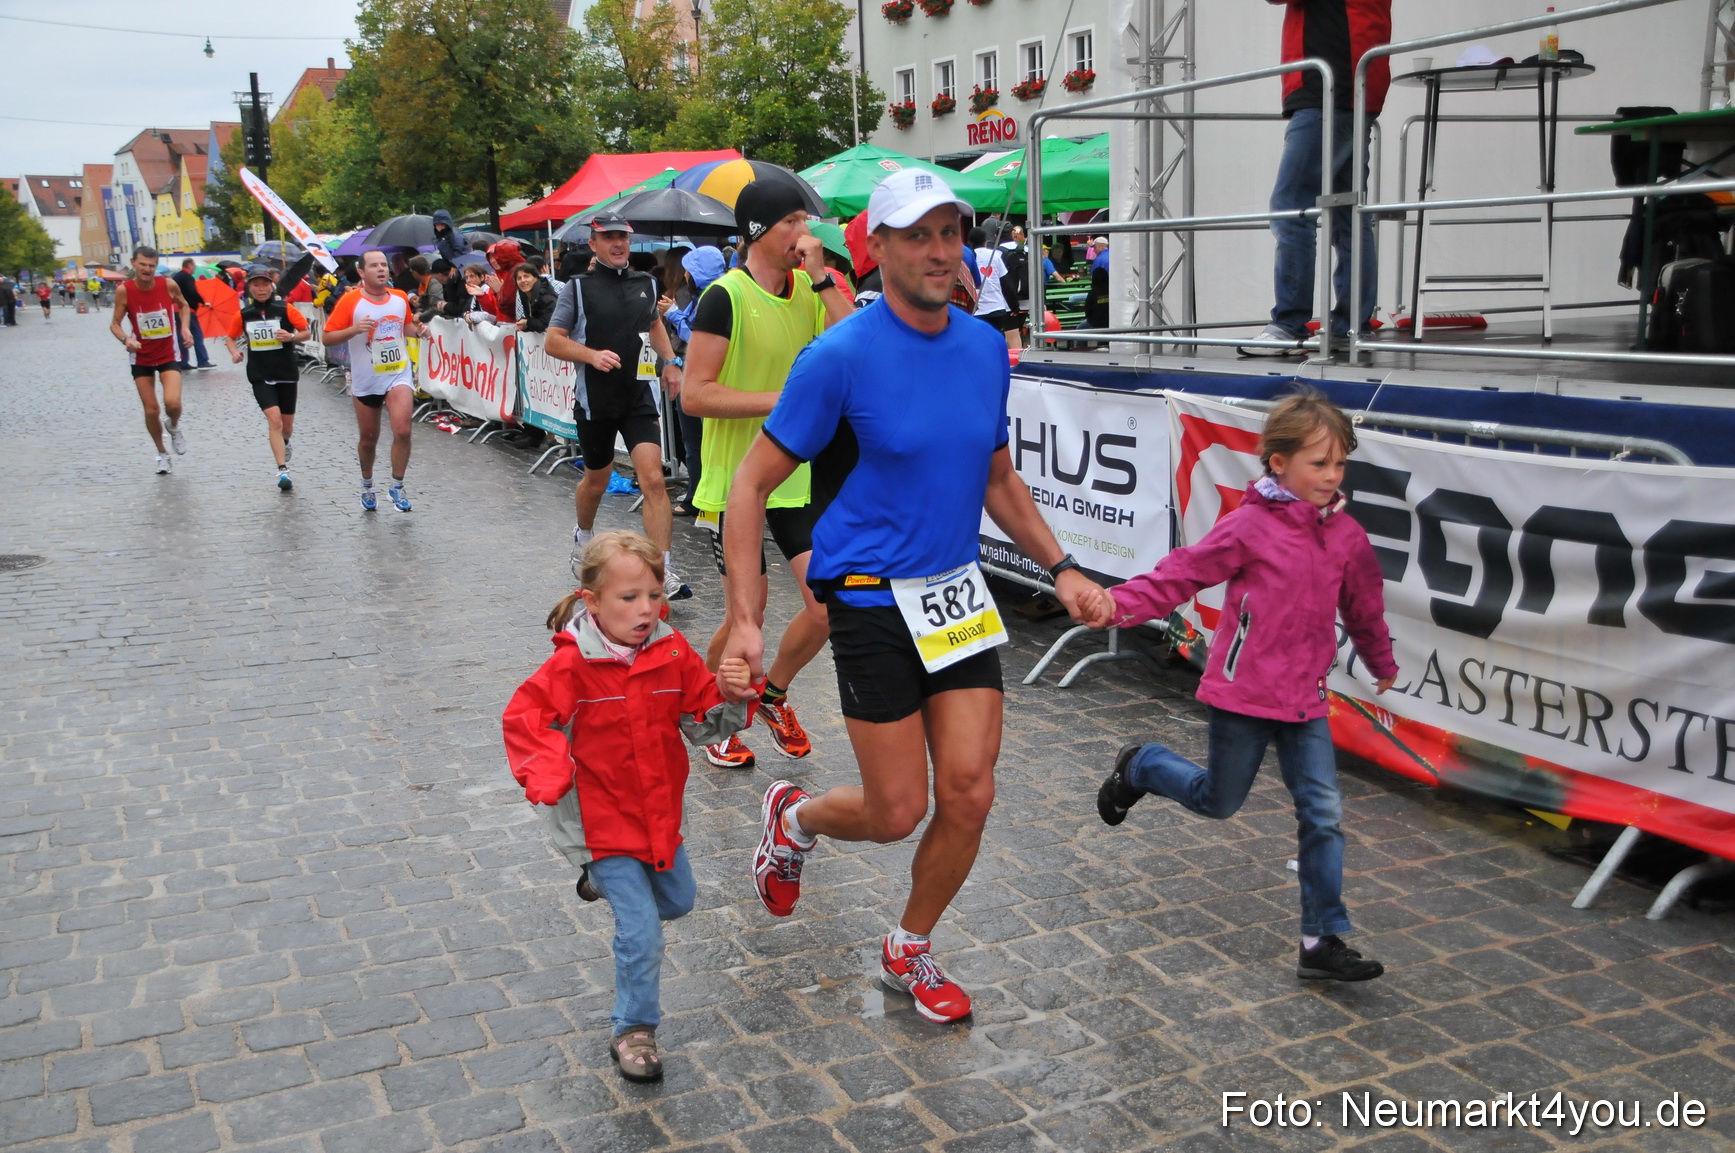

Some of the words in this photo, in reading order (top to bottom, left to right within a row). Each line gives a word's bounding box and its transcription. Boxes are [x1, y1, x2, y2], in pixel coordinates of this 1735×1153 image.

[967, 117, 1017, 146] RENO
[144, 318, 165, 330] 124
[254, 328, 274, 340] 501
[380, 348, 401, 363] 500
[428, 335, 500, 403] Oberbnk
[1072, 498, 1135, 528] GMBH
[1056, 529, 1092, 549] KONZEPT
[1101, 542, 1136, 560] DESIGN
[920, 577, 985, 627] 582
[947, 622, 985, 646] Rolan
